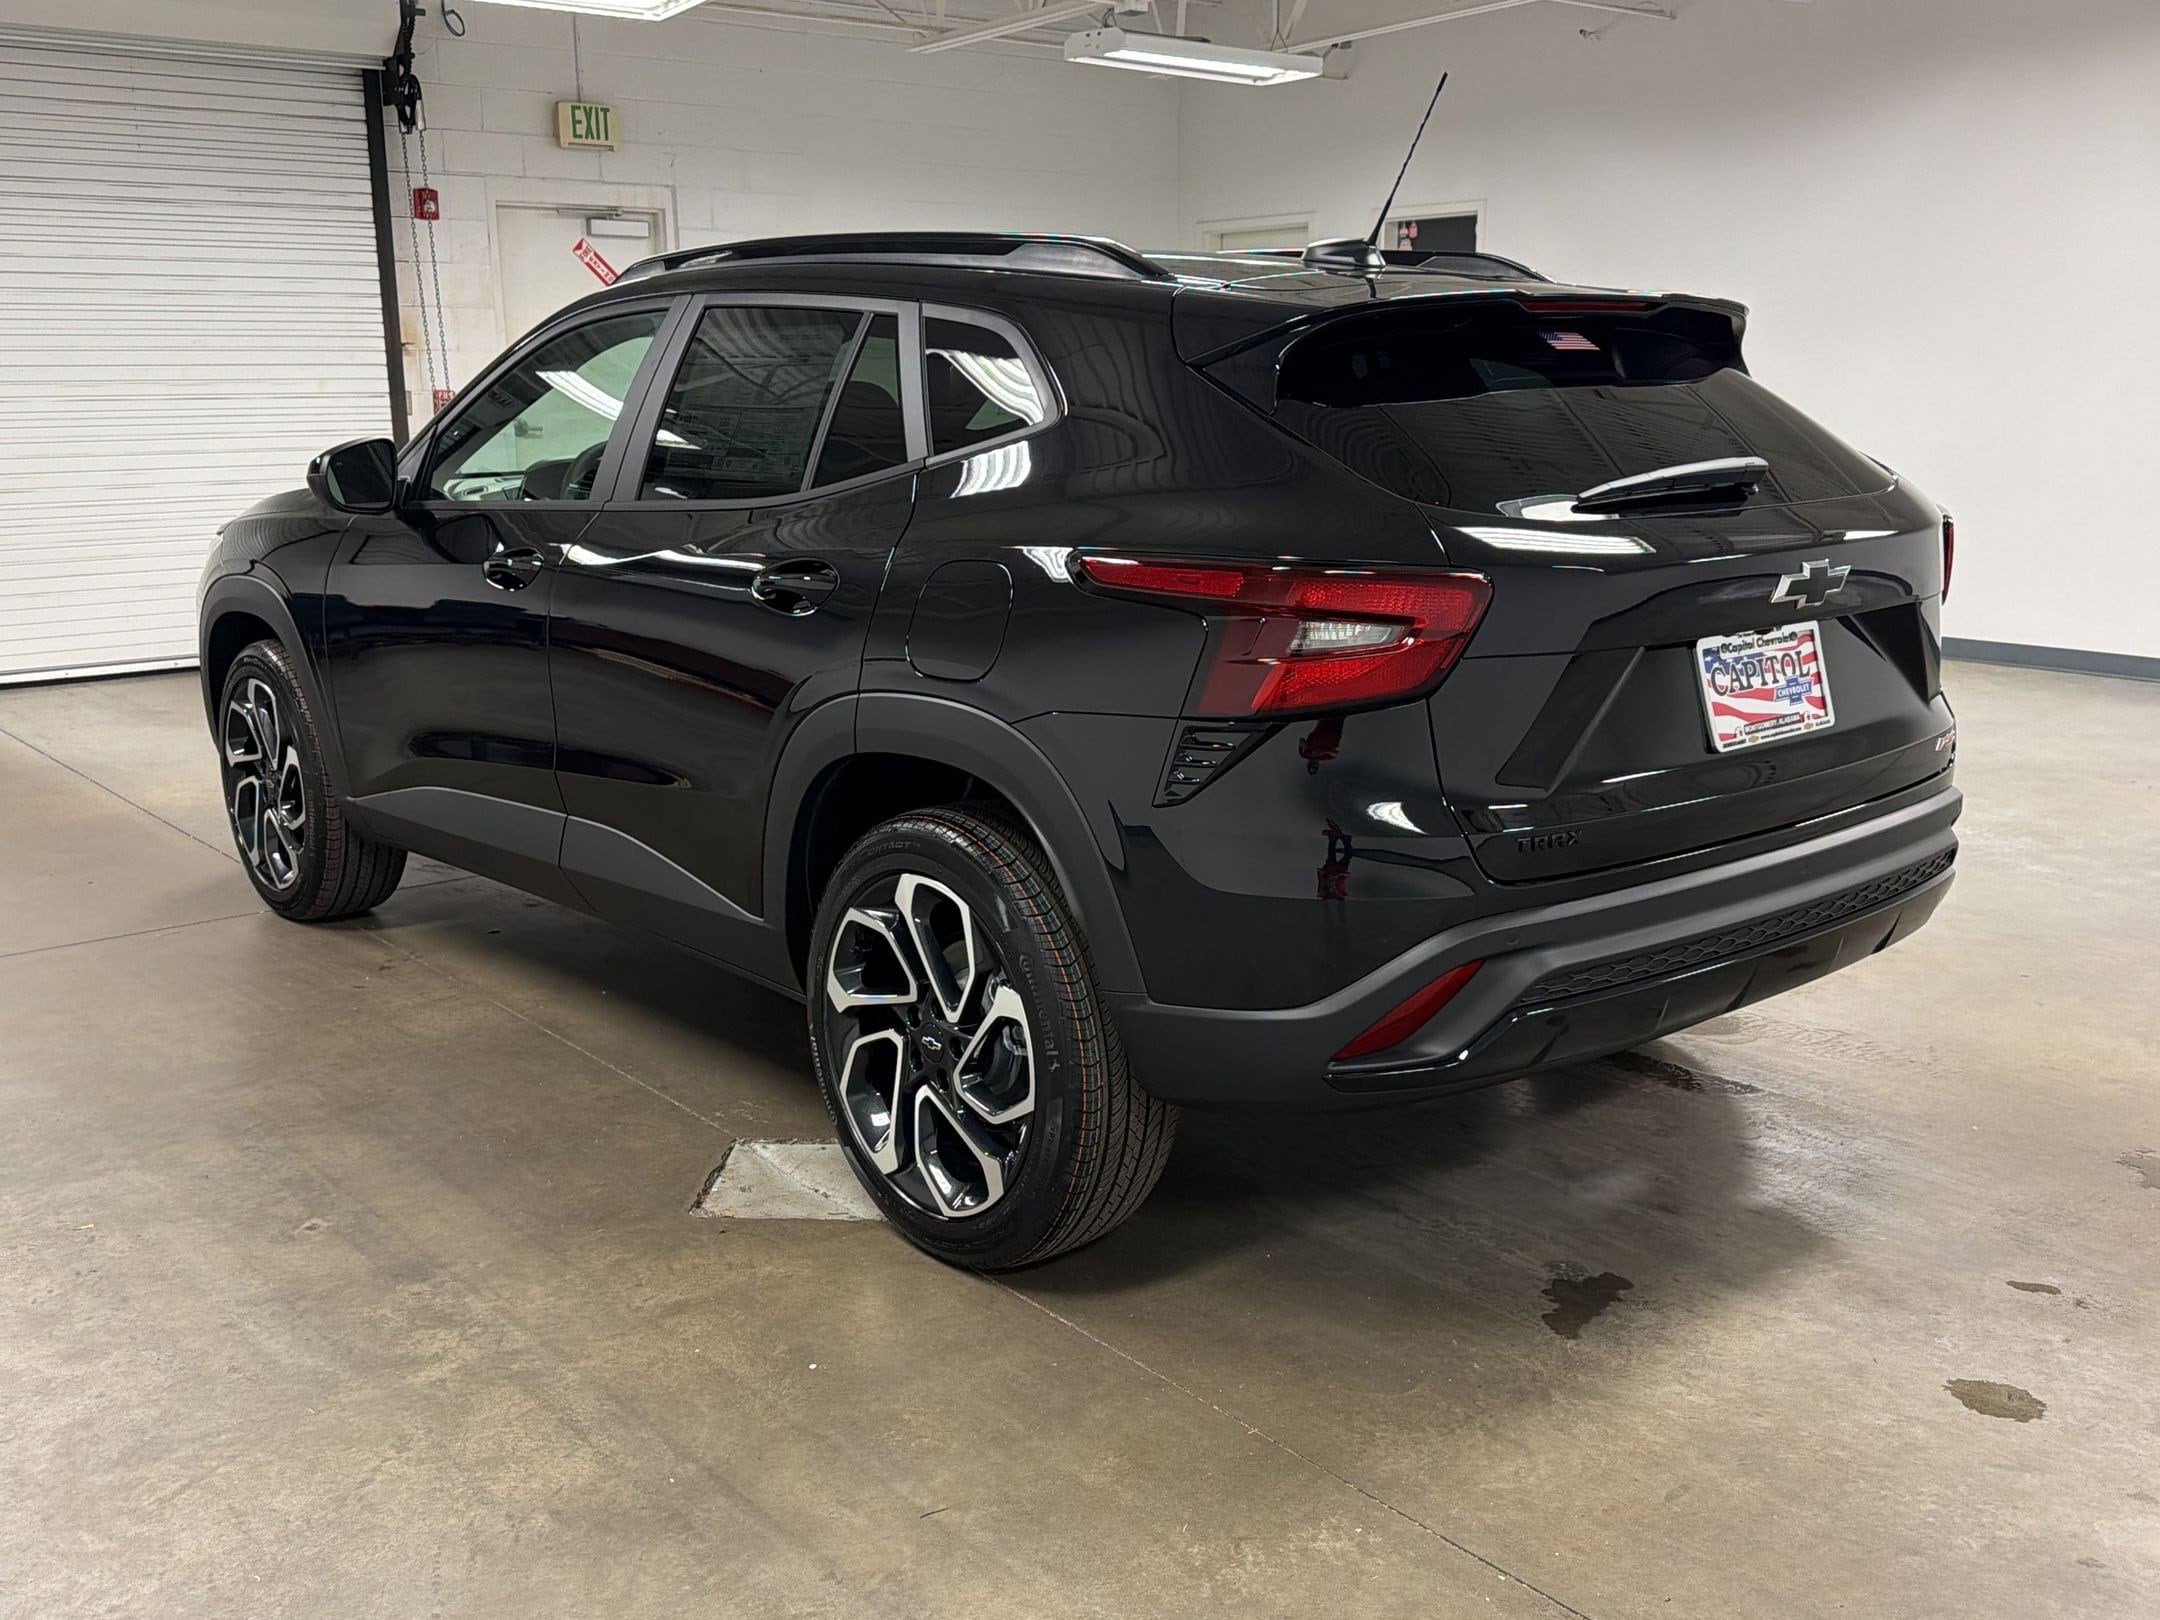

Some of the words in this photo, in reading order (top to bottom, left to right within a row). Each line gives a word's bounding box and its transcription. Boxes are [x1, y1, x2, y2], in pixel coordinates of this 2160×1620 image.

[570, 104, 610, 141] EXIT
[1727, 637, 1755, 655] Capitol
[1710, 650, 1811, 697] CAPITOL
[1777, 683, 1810, 697] CHEVROLET
